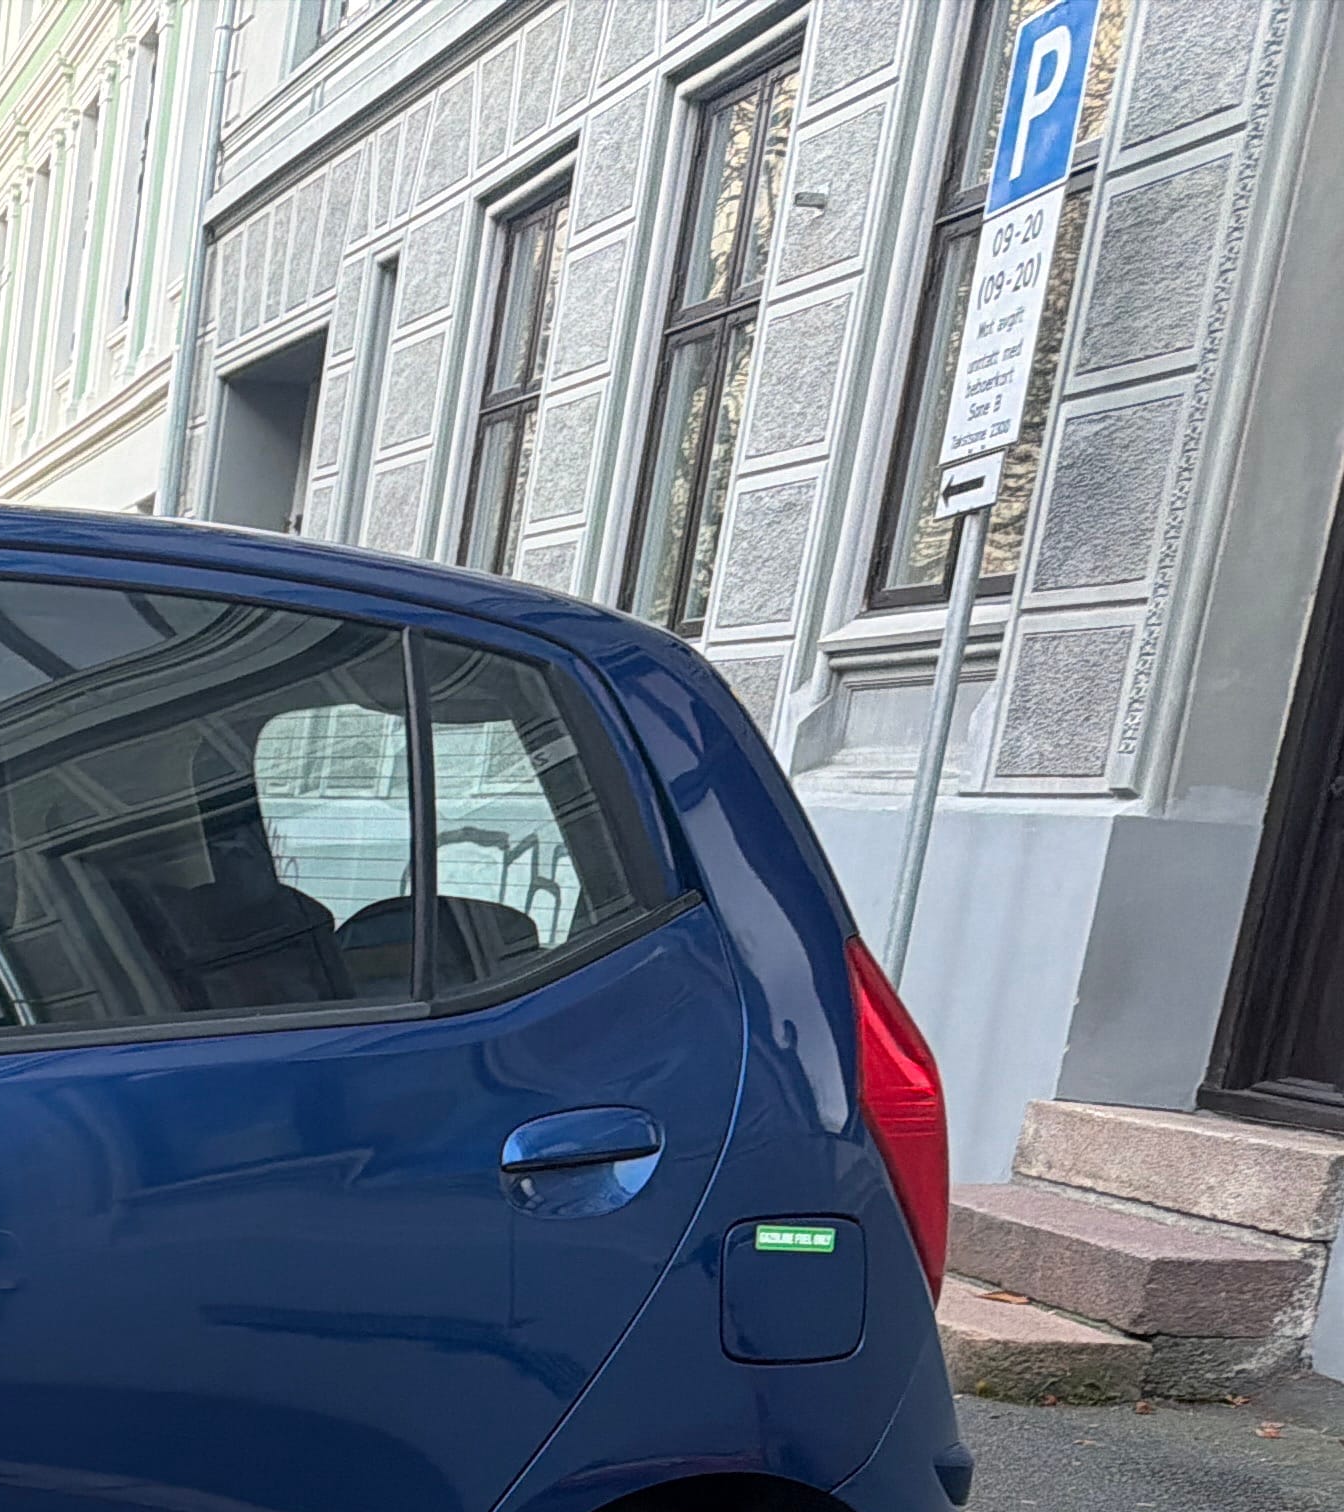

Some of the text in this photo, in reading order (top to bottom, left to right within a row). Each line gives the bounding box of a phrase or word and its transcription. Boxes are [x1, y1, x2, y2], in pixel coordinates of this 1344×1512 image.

[1009, 25, 1072, 182] P
[993, 209, 1044, 257] 09-20
[977, 252, 1042, 310] (09-20)
